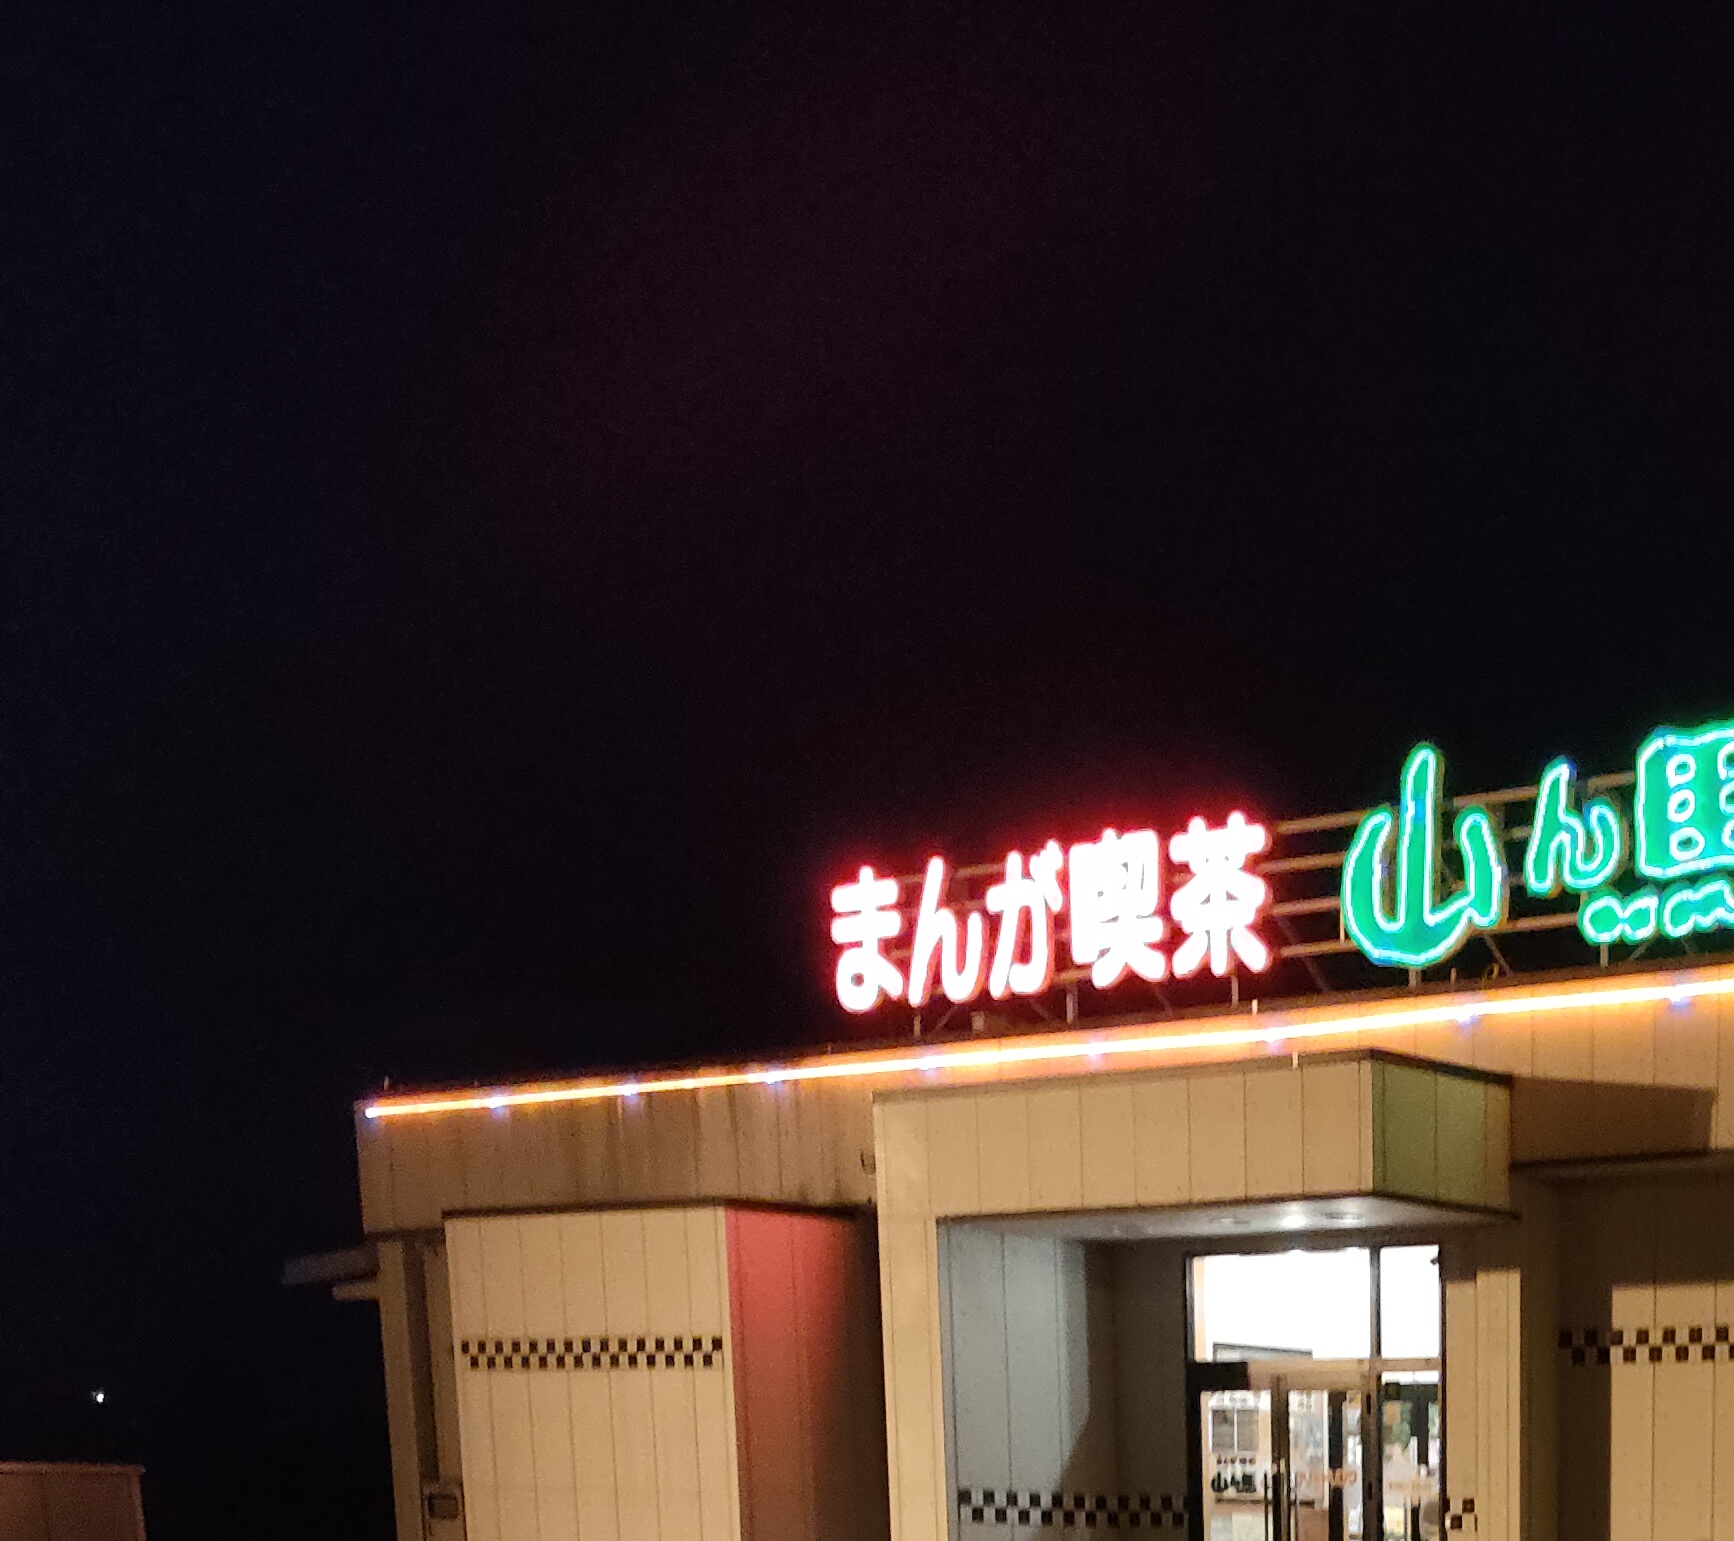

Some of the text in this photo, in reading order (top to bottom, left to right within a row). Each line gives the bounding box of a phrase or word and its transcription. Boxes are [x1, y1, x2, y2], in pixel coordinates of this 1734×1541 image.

[829, 809, 1273, 1013] まんが喫茶
